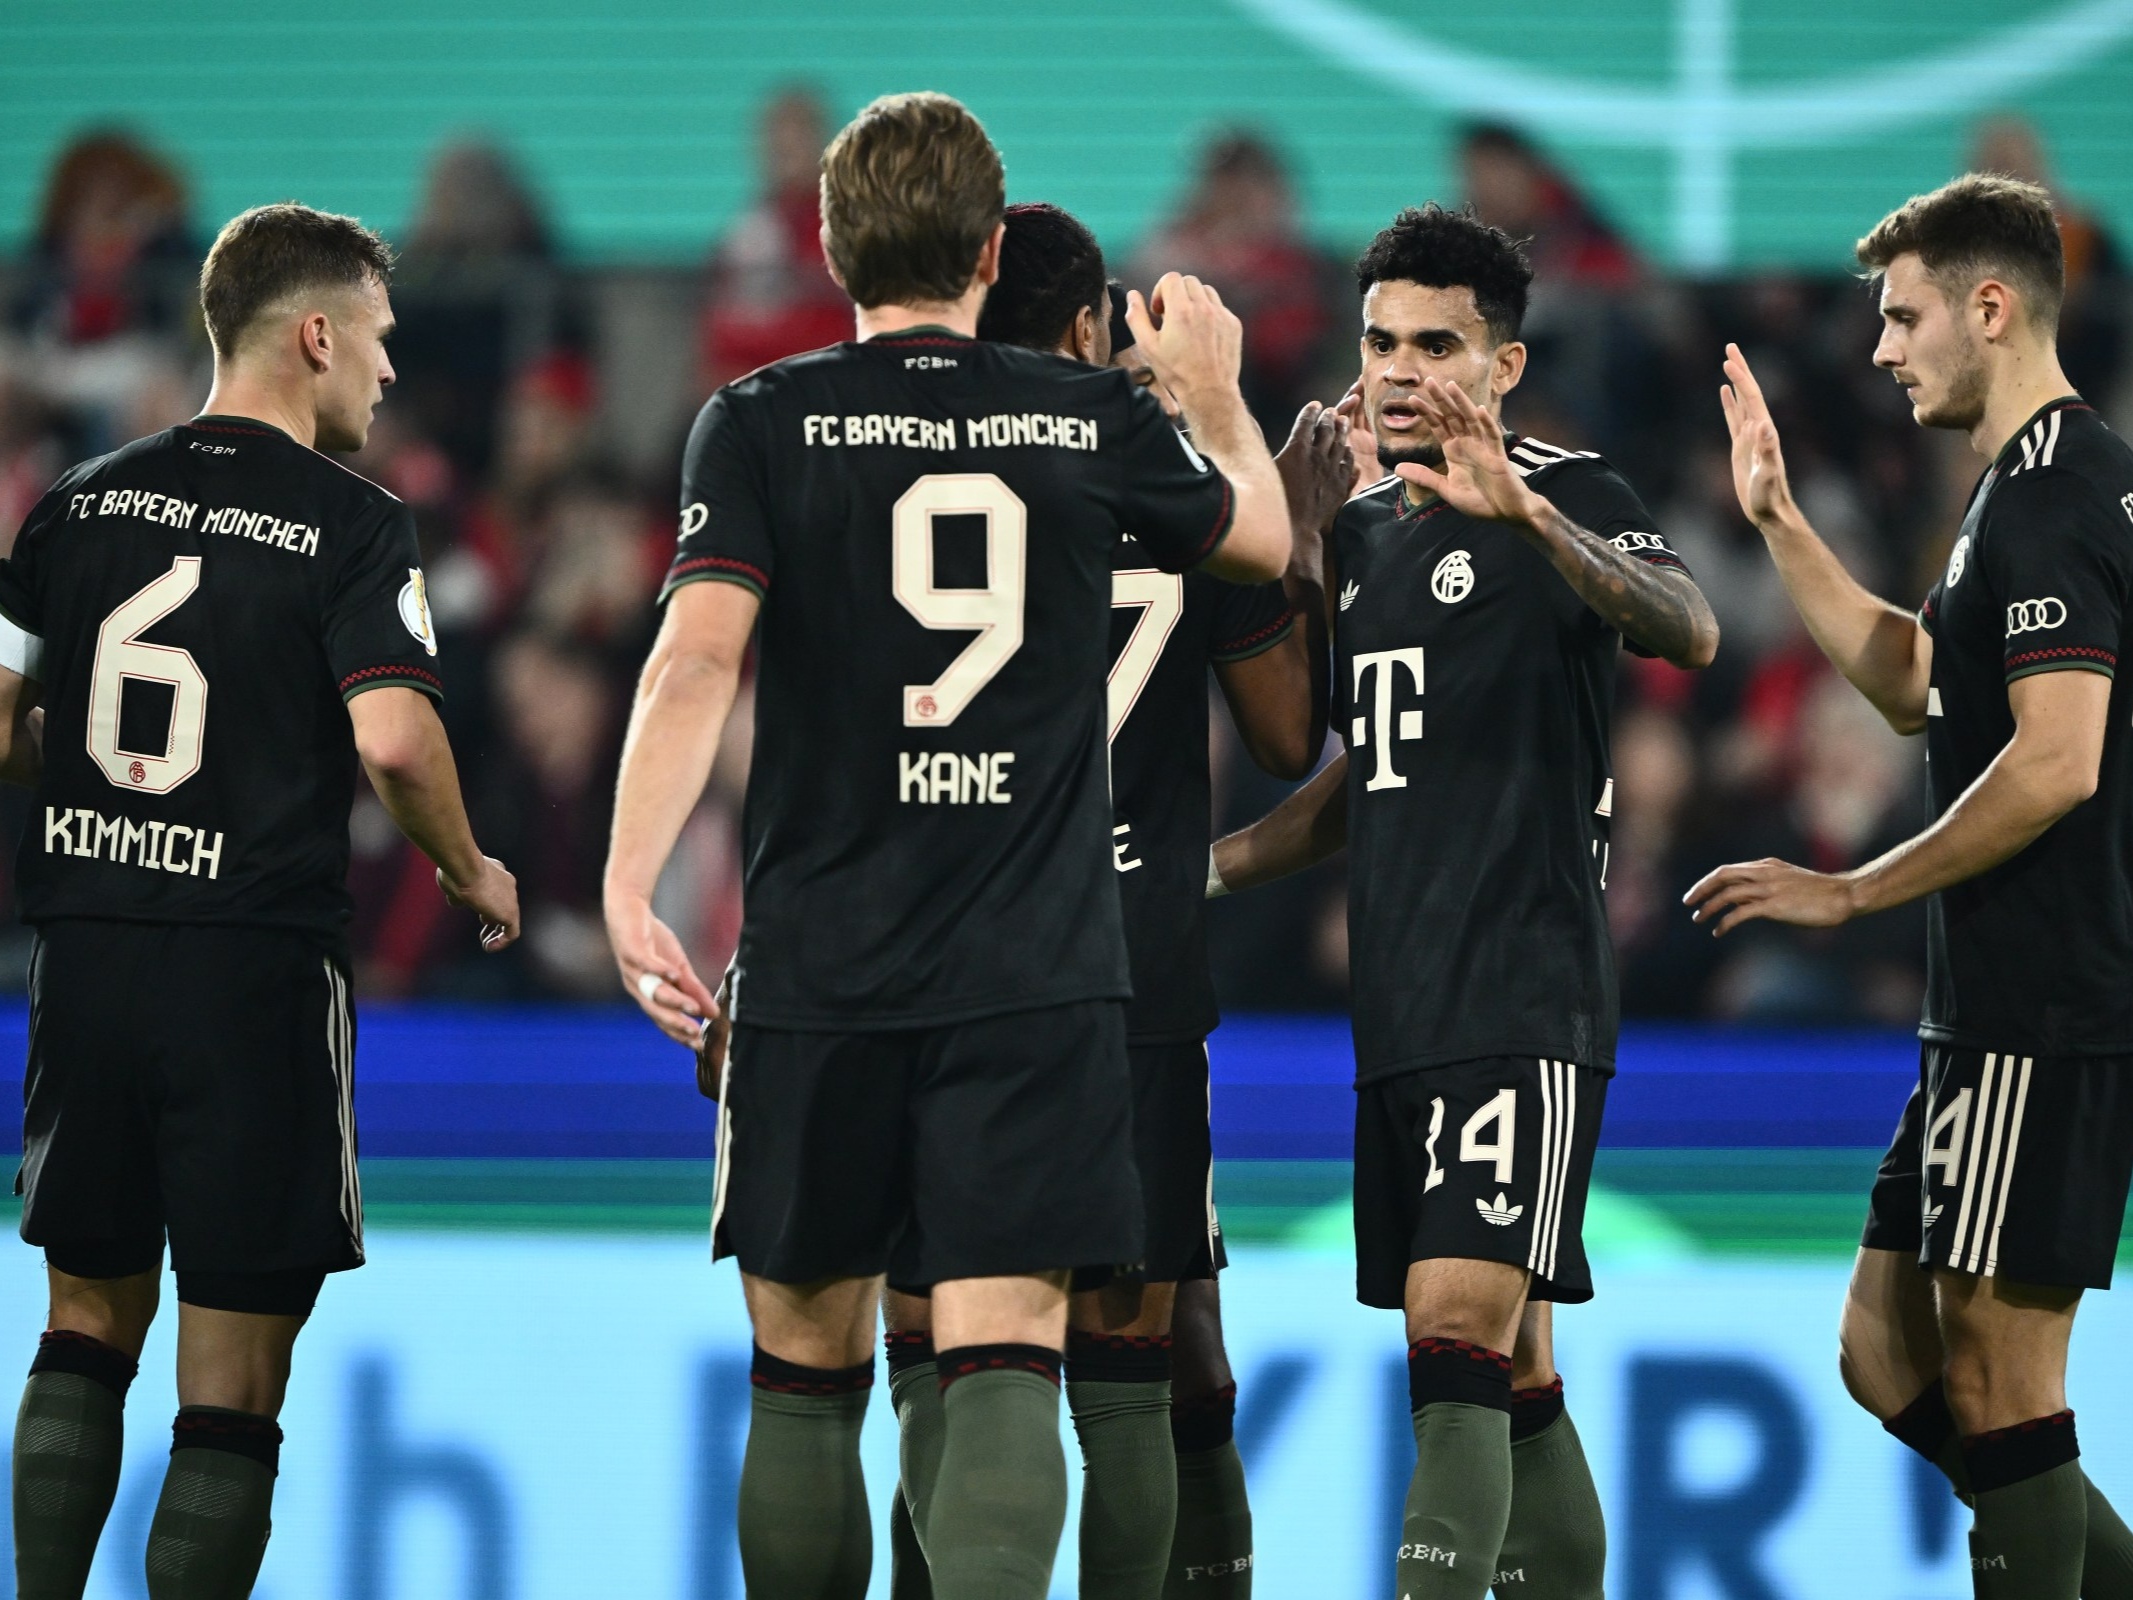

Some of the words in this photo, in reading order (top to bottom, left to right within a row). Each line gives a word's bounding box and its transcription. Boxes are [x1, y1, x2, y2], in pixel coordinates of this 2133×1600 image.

[189, 441, 237, 456] FCBM
[803, 414, 841, 447] FC
[844, 414, 957, 452] BAYERN
[66, 493, 97, 521] FC
[98, 489, 199, 530] BAYERN
[892, 472, 1028, 728] 9
[86, 555, 209, 795] 6
[899, 751, 1015, 805] KANE
[45, 806, 224, 880] KIMMICH
[1422, 1088, 1517, 1195] 14
